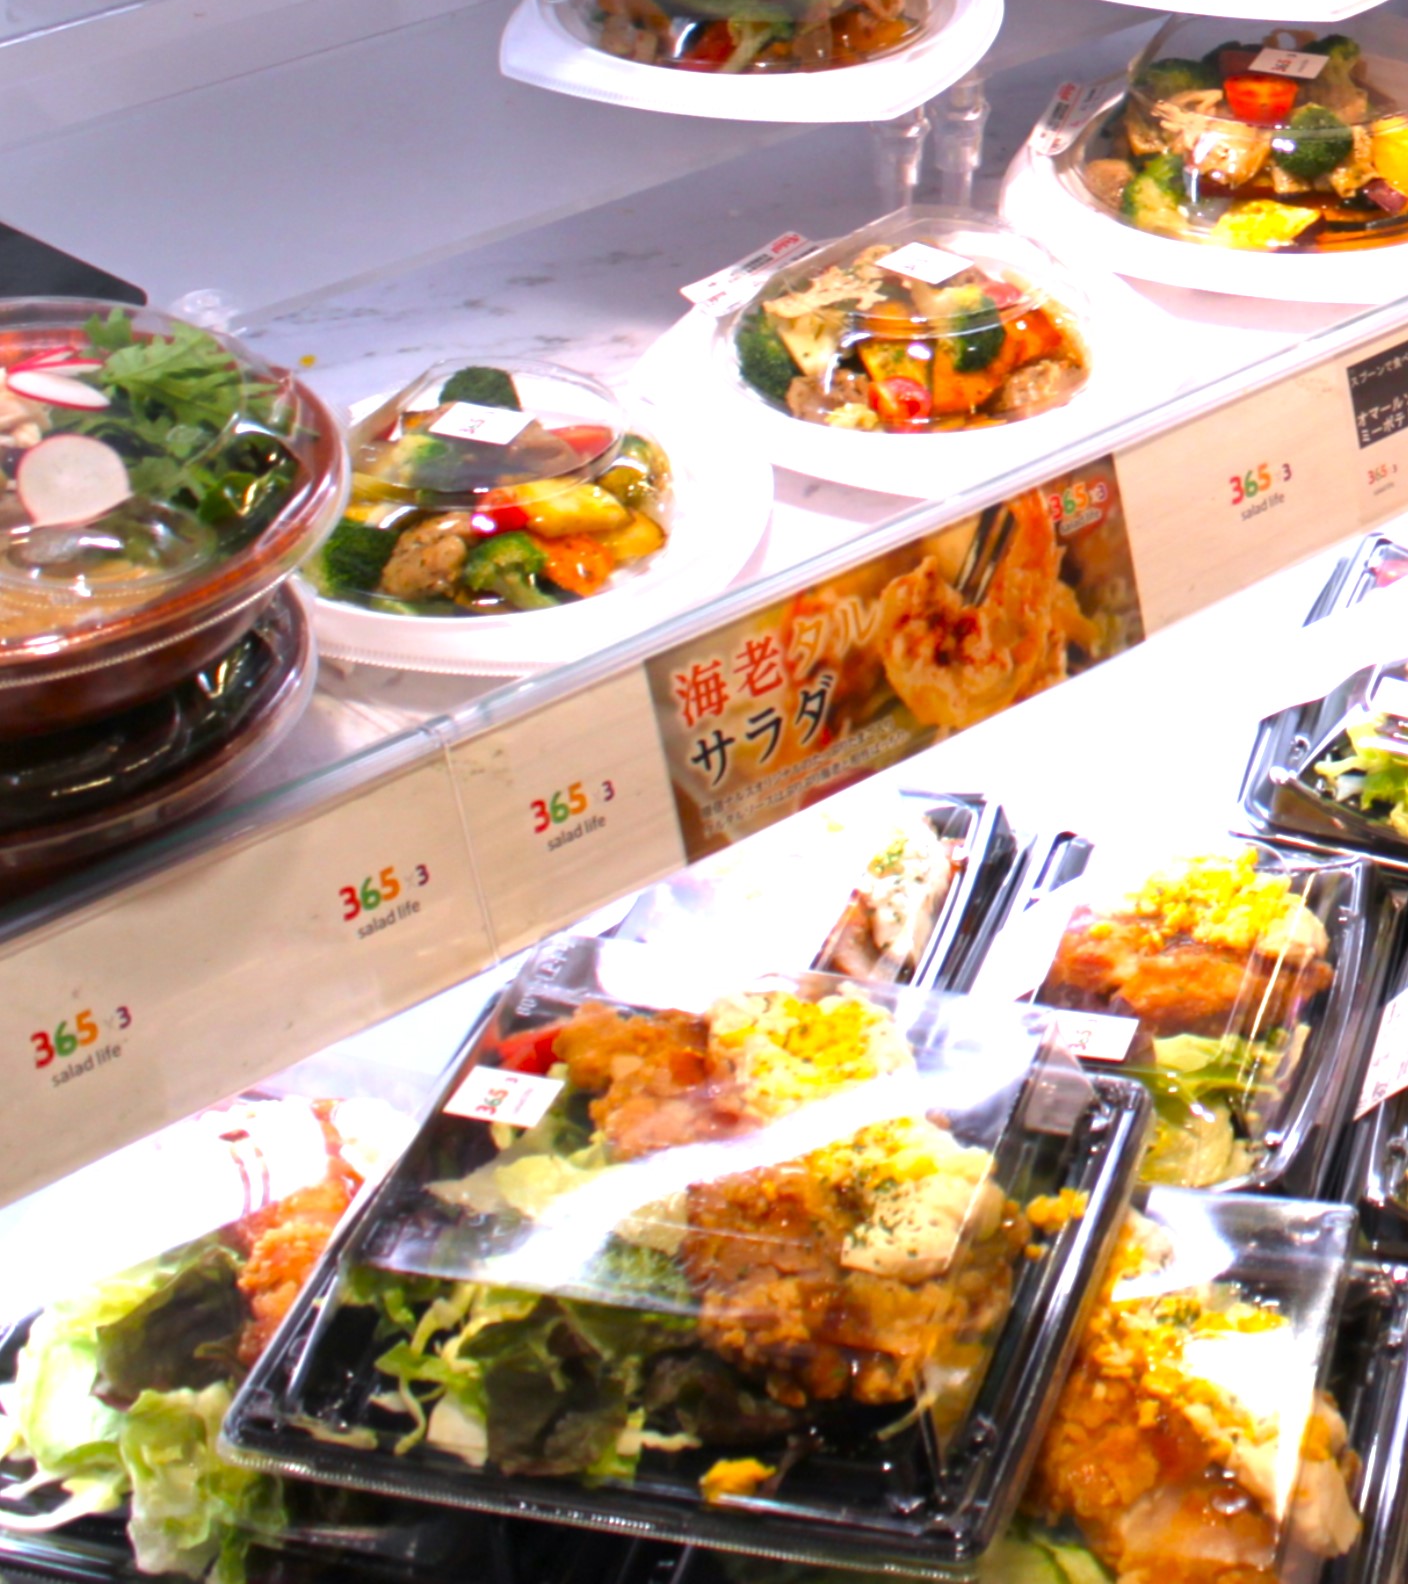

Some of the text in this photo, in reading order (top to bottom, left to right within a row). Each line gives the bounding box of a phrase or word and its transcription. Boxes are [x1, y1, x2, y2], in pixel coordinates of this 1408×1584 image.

[1048, 481, 1090, 521] 365
[1229, 462, 1272, 506] 365
[675, 598, 881, 727] 海老タル
[690, 674, 834, 787] サラダ
[530, 782, 588, 834] 365
[546, 821, 584, 851] salad
[339, 866, 400, 921] 365
[356, 907, 396, 939] salad
[30, 1008, 99, 1069] 365
[51, 1053, 96, 1087] salad
